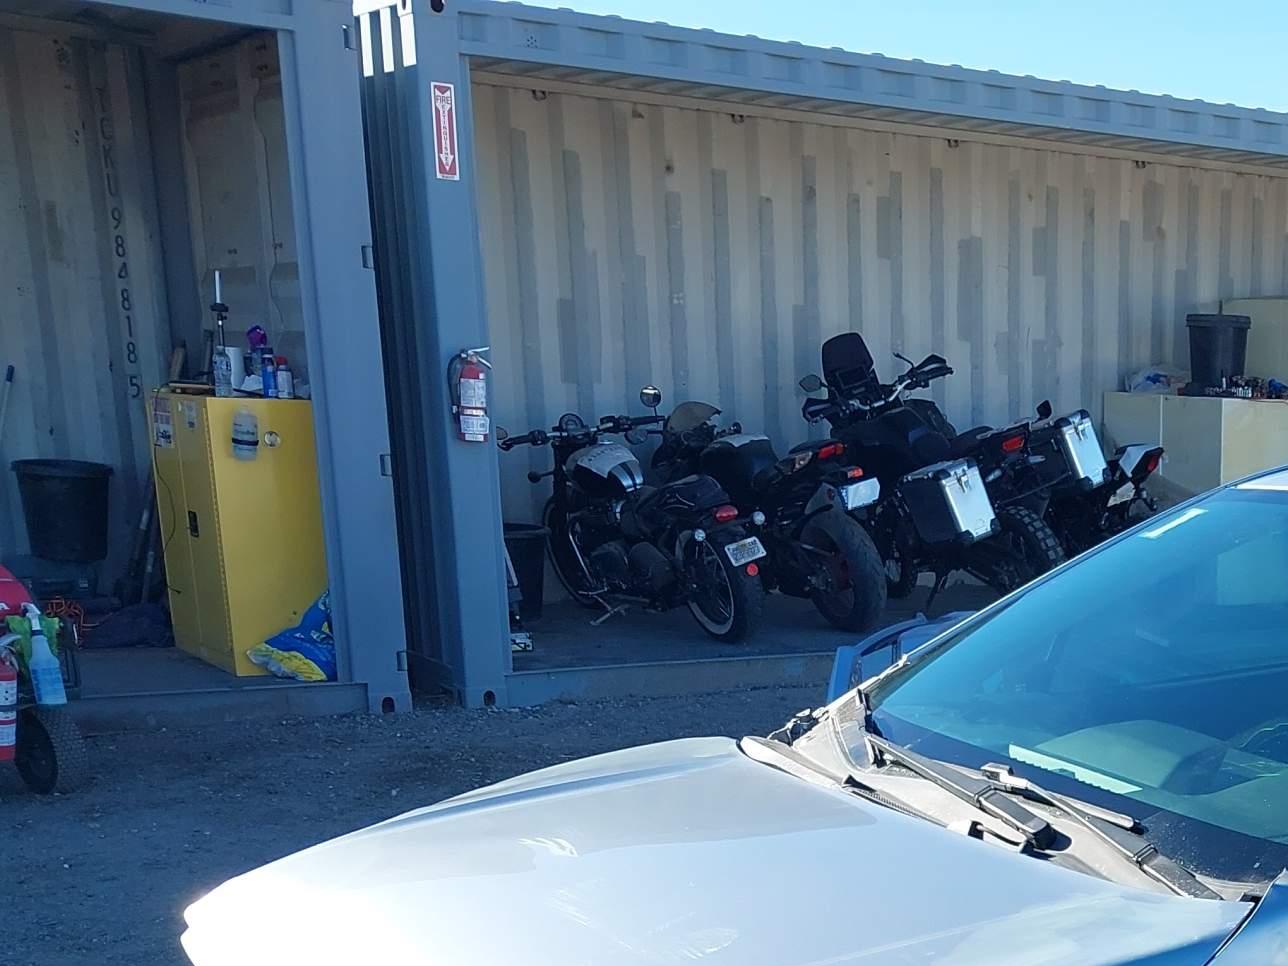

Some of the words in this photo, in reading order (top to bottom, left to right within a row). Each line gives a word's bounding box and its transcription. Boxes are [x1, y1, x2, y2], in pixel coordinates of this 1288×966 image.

[434, 95, 452, 105] FIRE
[111, 206, 138, 364] 984818
[128, 375, 142, 399] 5
